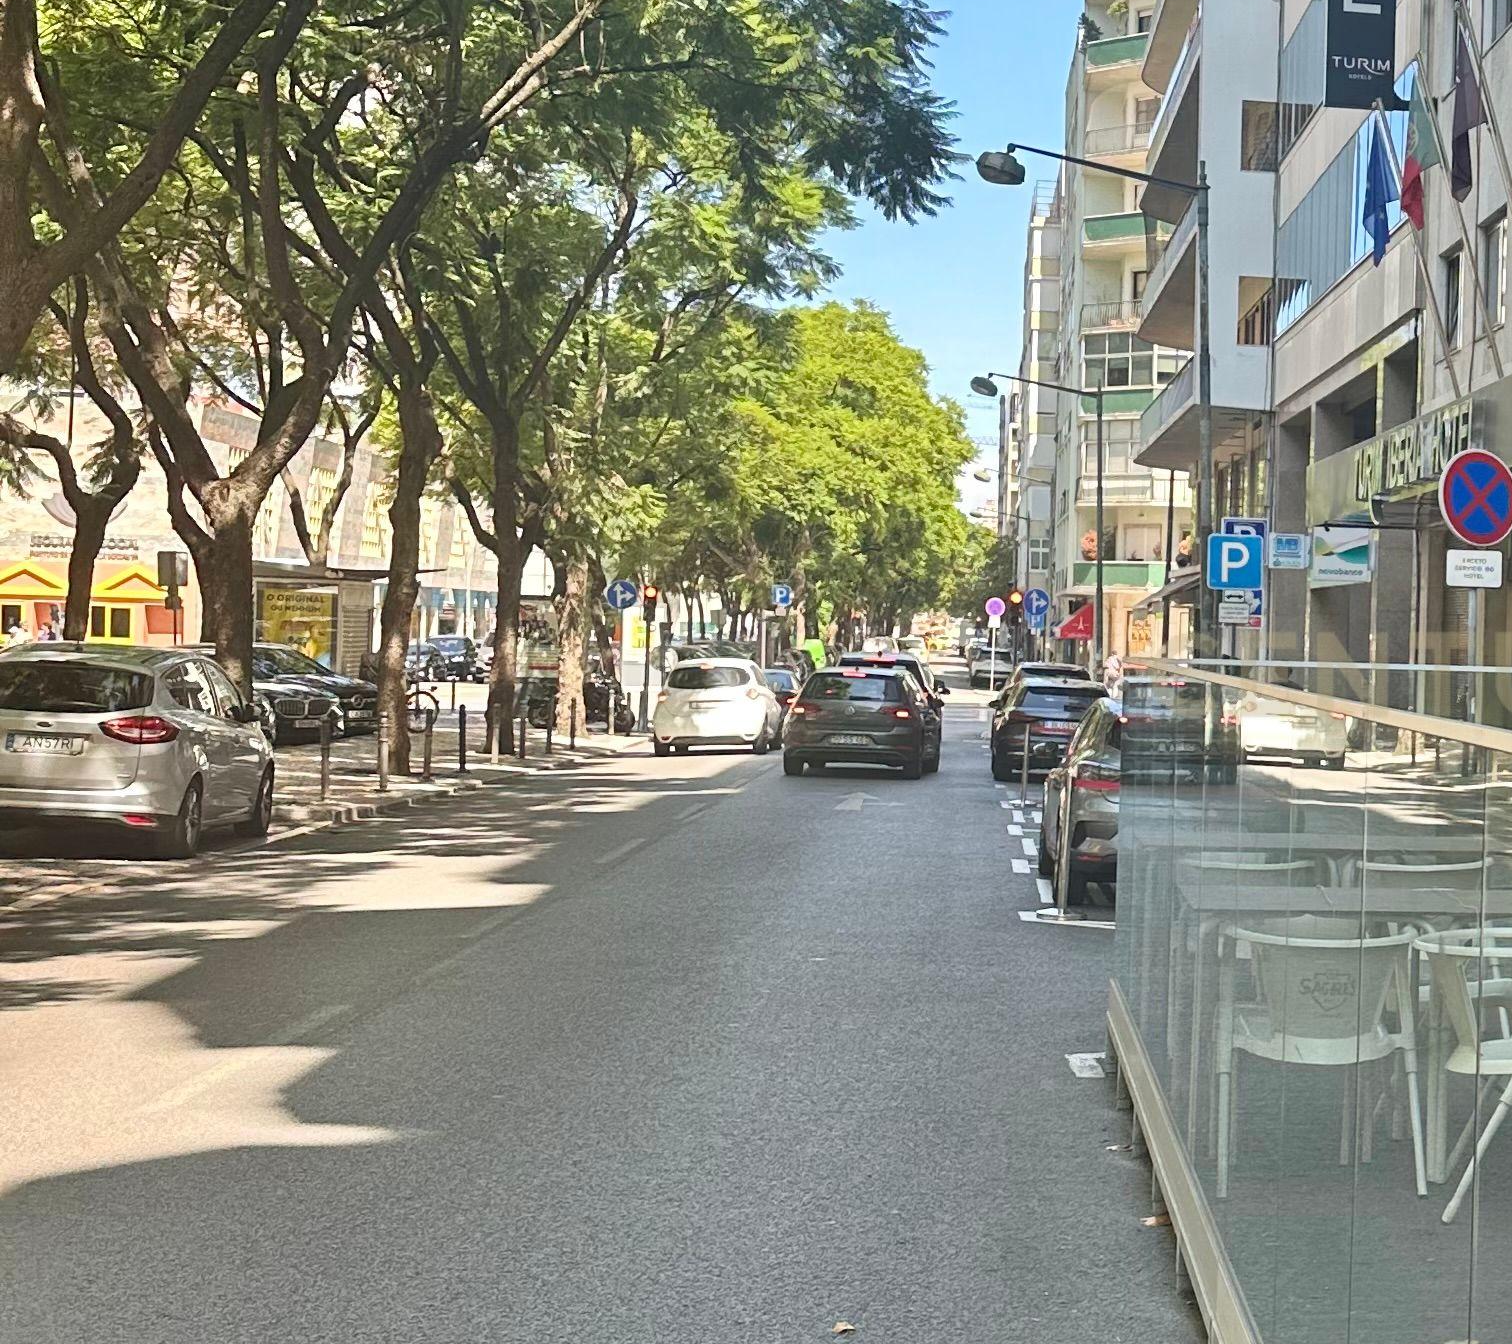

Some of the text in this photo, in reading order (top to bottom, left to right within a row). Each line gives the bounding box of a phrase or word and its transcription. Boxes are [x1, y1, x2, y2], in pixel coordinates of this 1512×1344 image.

[1332, 56, 1391, 75] TURIM
[1221, 541, 1250, 583] P
[775, 587, 787, 603] P
